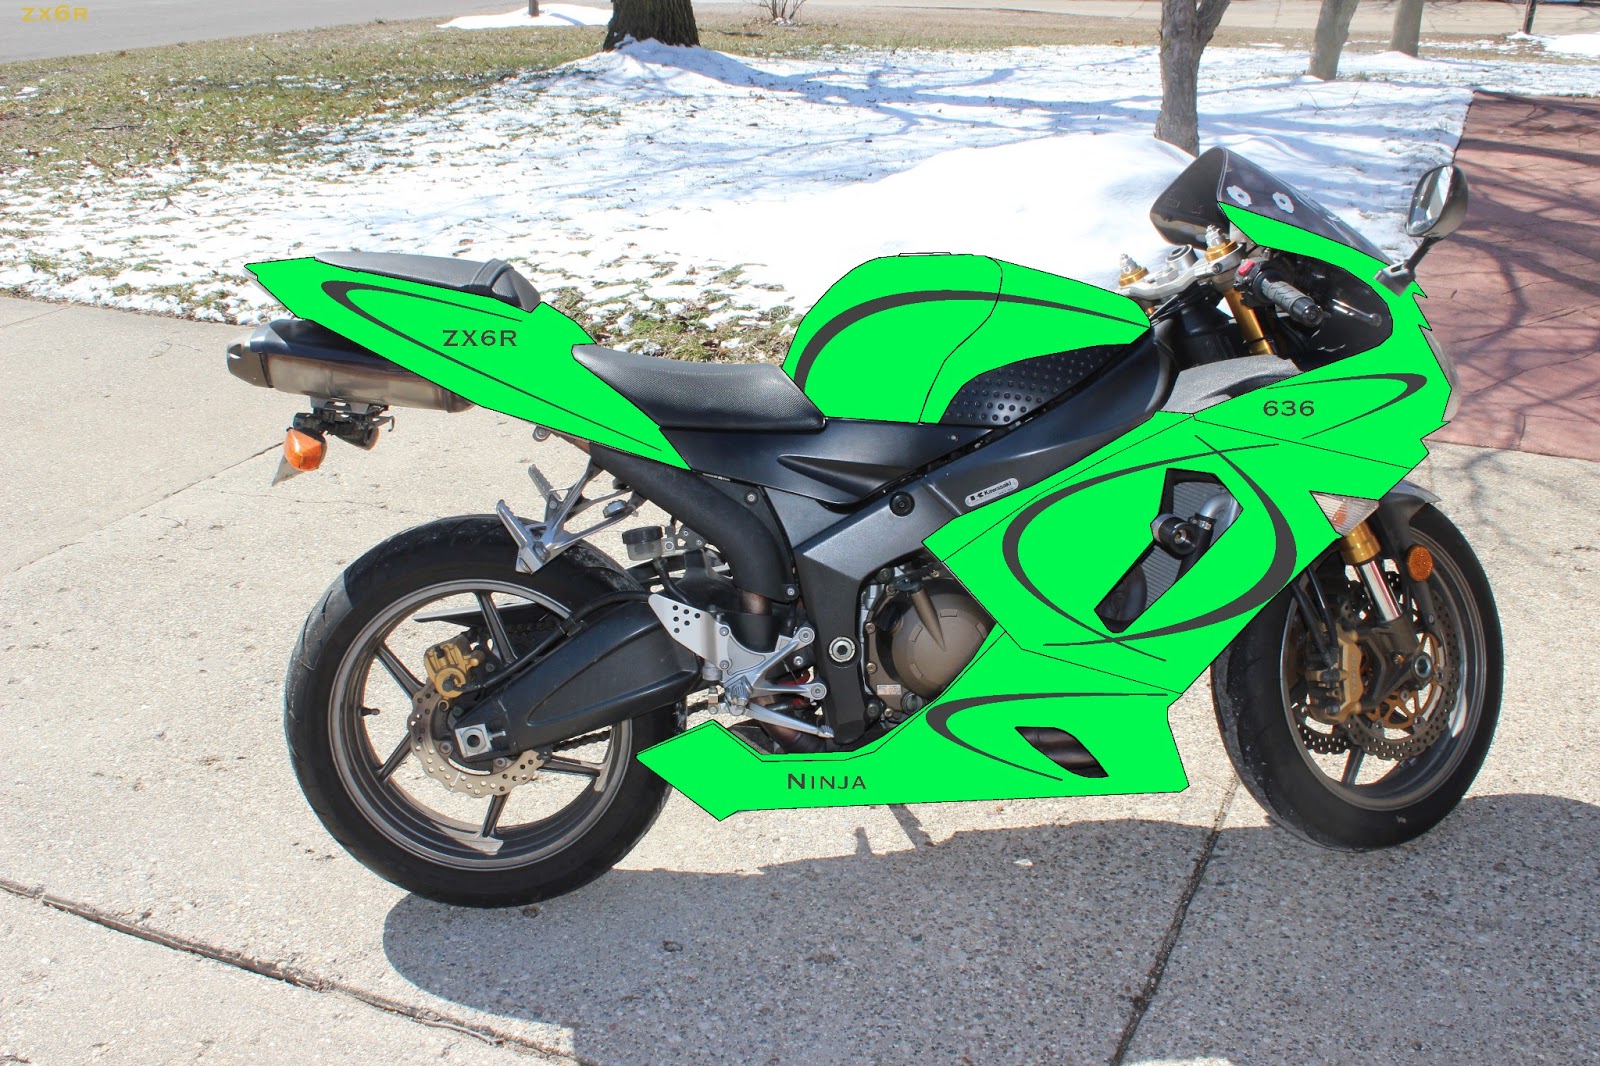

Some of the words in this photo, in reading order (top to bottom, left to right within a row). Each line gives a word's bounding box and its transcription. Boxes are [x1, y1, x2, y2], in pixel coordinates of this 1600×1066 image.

[442, 329, 518, 347] ZX6R
[1263, 400, 1315, 417] 636
[984, 481, 1012, 496] Kawasaki
[787, 773, 867, 790] NINJA
